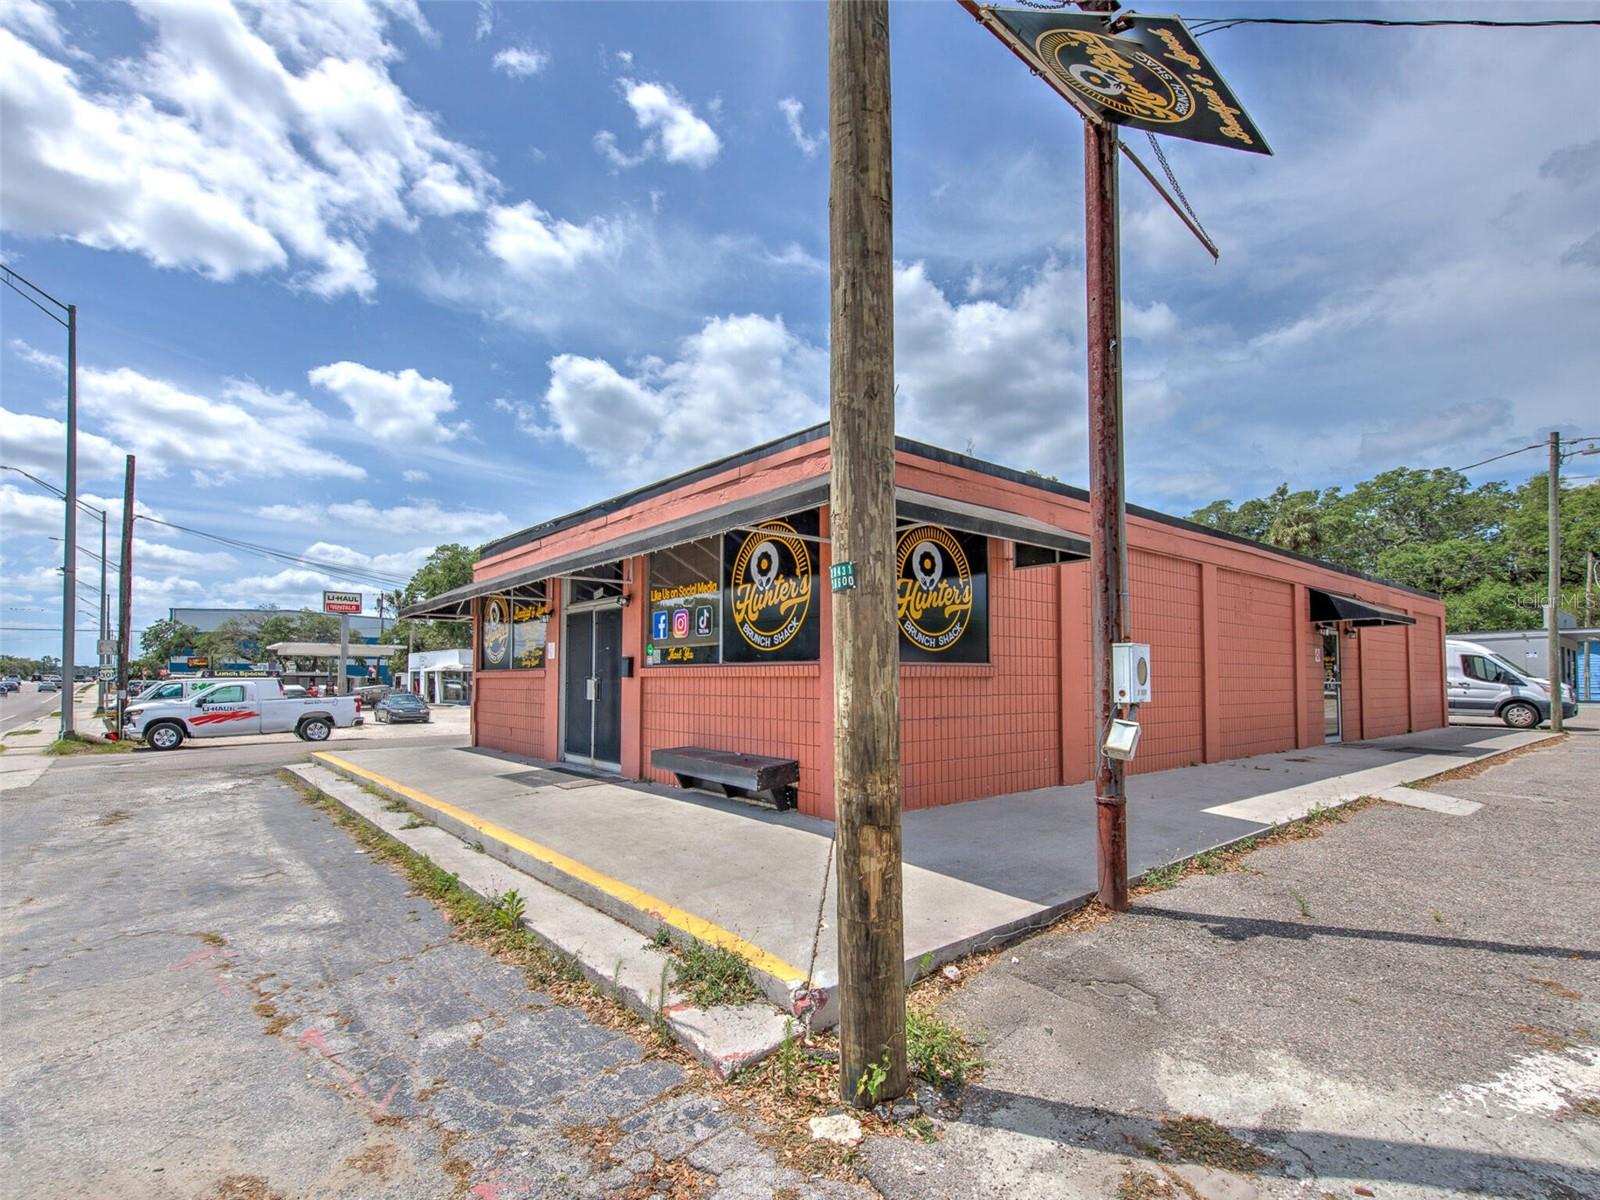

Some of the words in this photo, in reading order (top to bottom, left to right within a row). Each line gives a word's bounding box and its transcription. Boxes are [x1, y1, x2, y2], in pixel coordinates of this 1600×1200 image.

[1147, 27, 1201, 71] Lunch
[1134, 51, 1174, 81] SHAC
[1170, 82, 1191, 116] BRUNCH
[327, 594, 359, 603] U-HAUL
[650, 590, 662, 602] Like
[662, 588, 670, 599] Us
[670, 589, 679, 598] on
[679, 584, 697, 597] Social
[697, 581, 717, 594] Media
[735, 574, 810, 623] Hunter's
[896, 578, 972, 620] Hunter's
[742, 622, 771, 647] BRUNCH
[773, 616, 799, 645] SHACK
[904, 620, 936, 647] BRUNCH
[938, 622, 963, 646] SHACK
